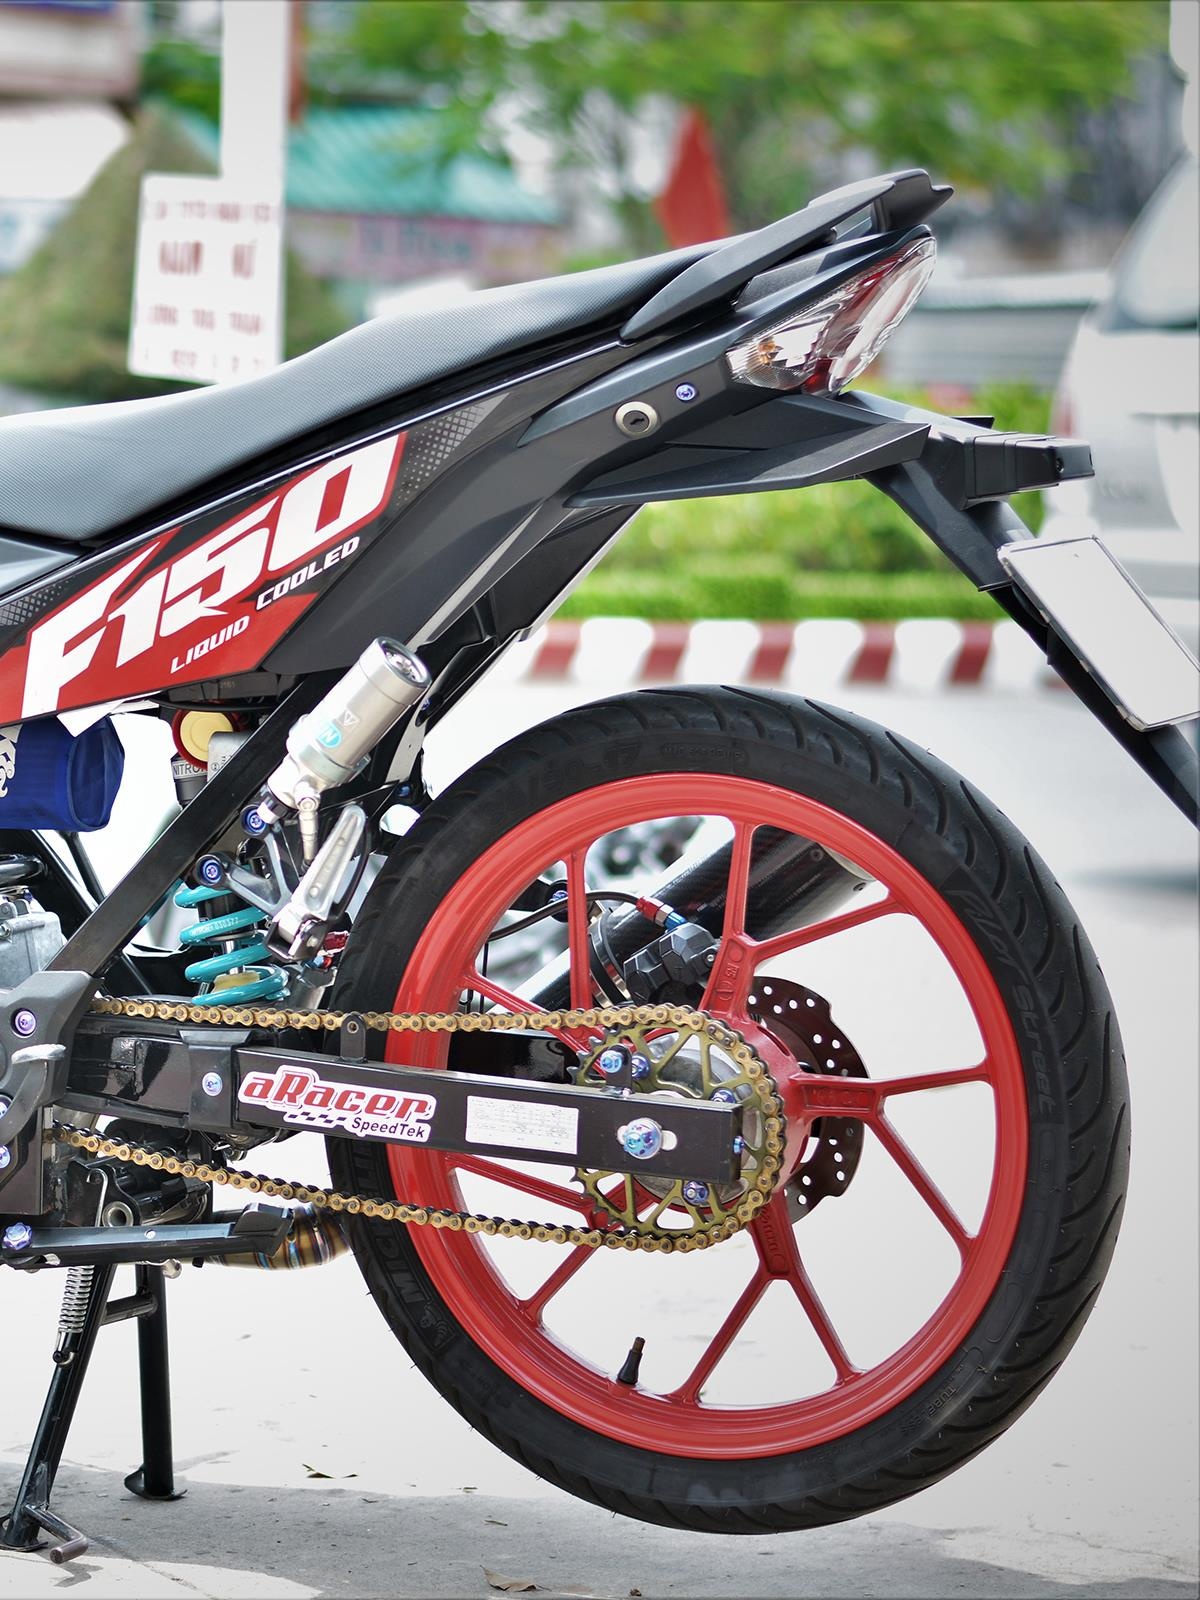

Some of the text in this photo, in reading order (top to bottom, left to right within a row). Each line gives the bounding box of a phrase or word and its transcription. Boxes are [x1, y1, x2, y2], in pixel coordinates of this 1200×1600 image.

[21, 434, 400, 718] F150
[170, 535, 360, 674] LIQUID COOLED
[243, 1072, 431, 1121] aRacer
[1011, 984, 1058, 1115] Street
[351, 1117, 425, 1139] SpeedTek
